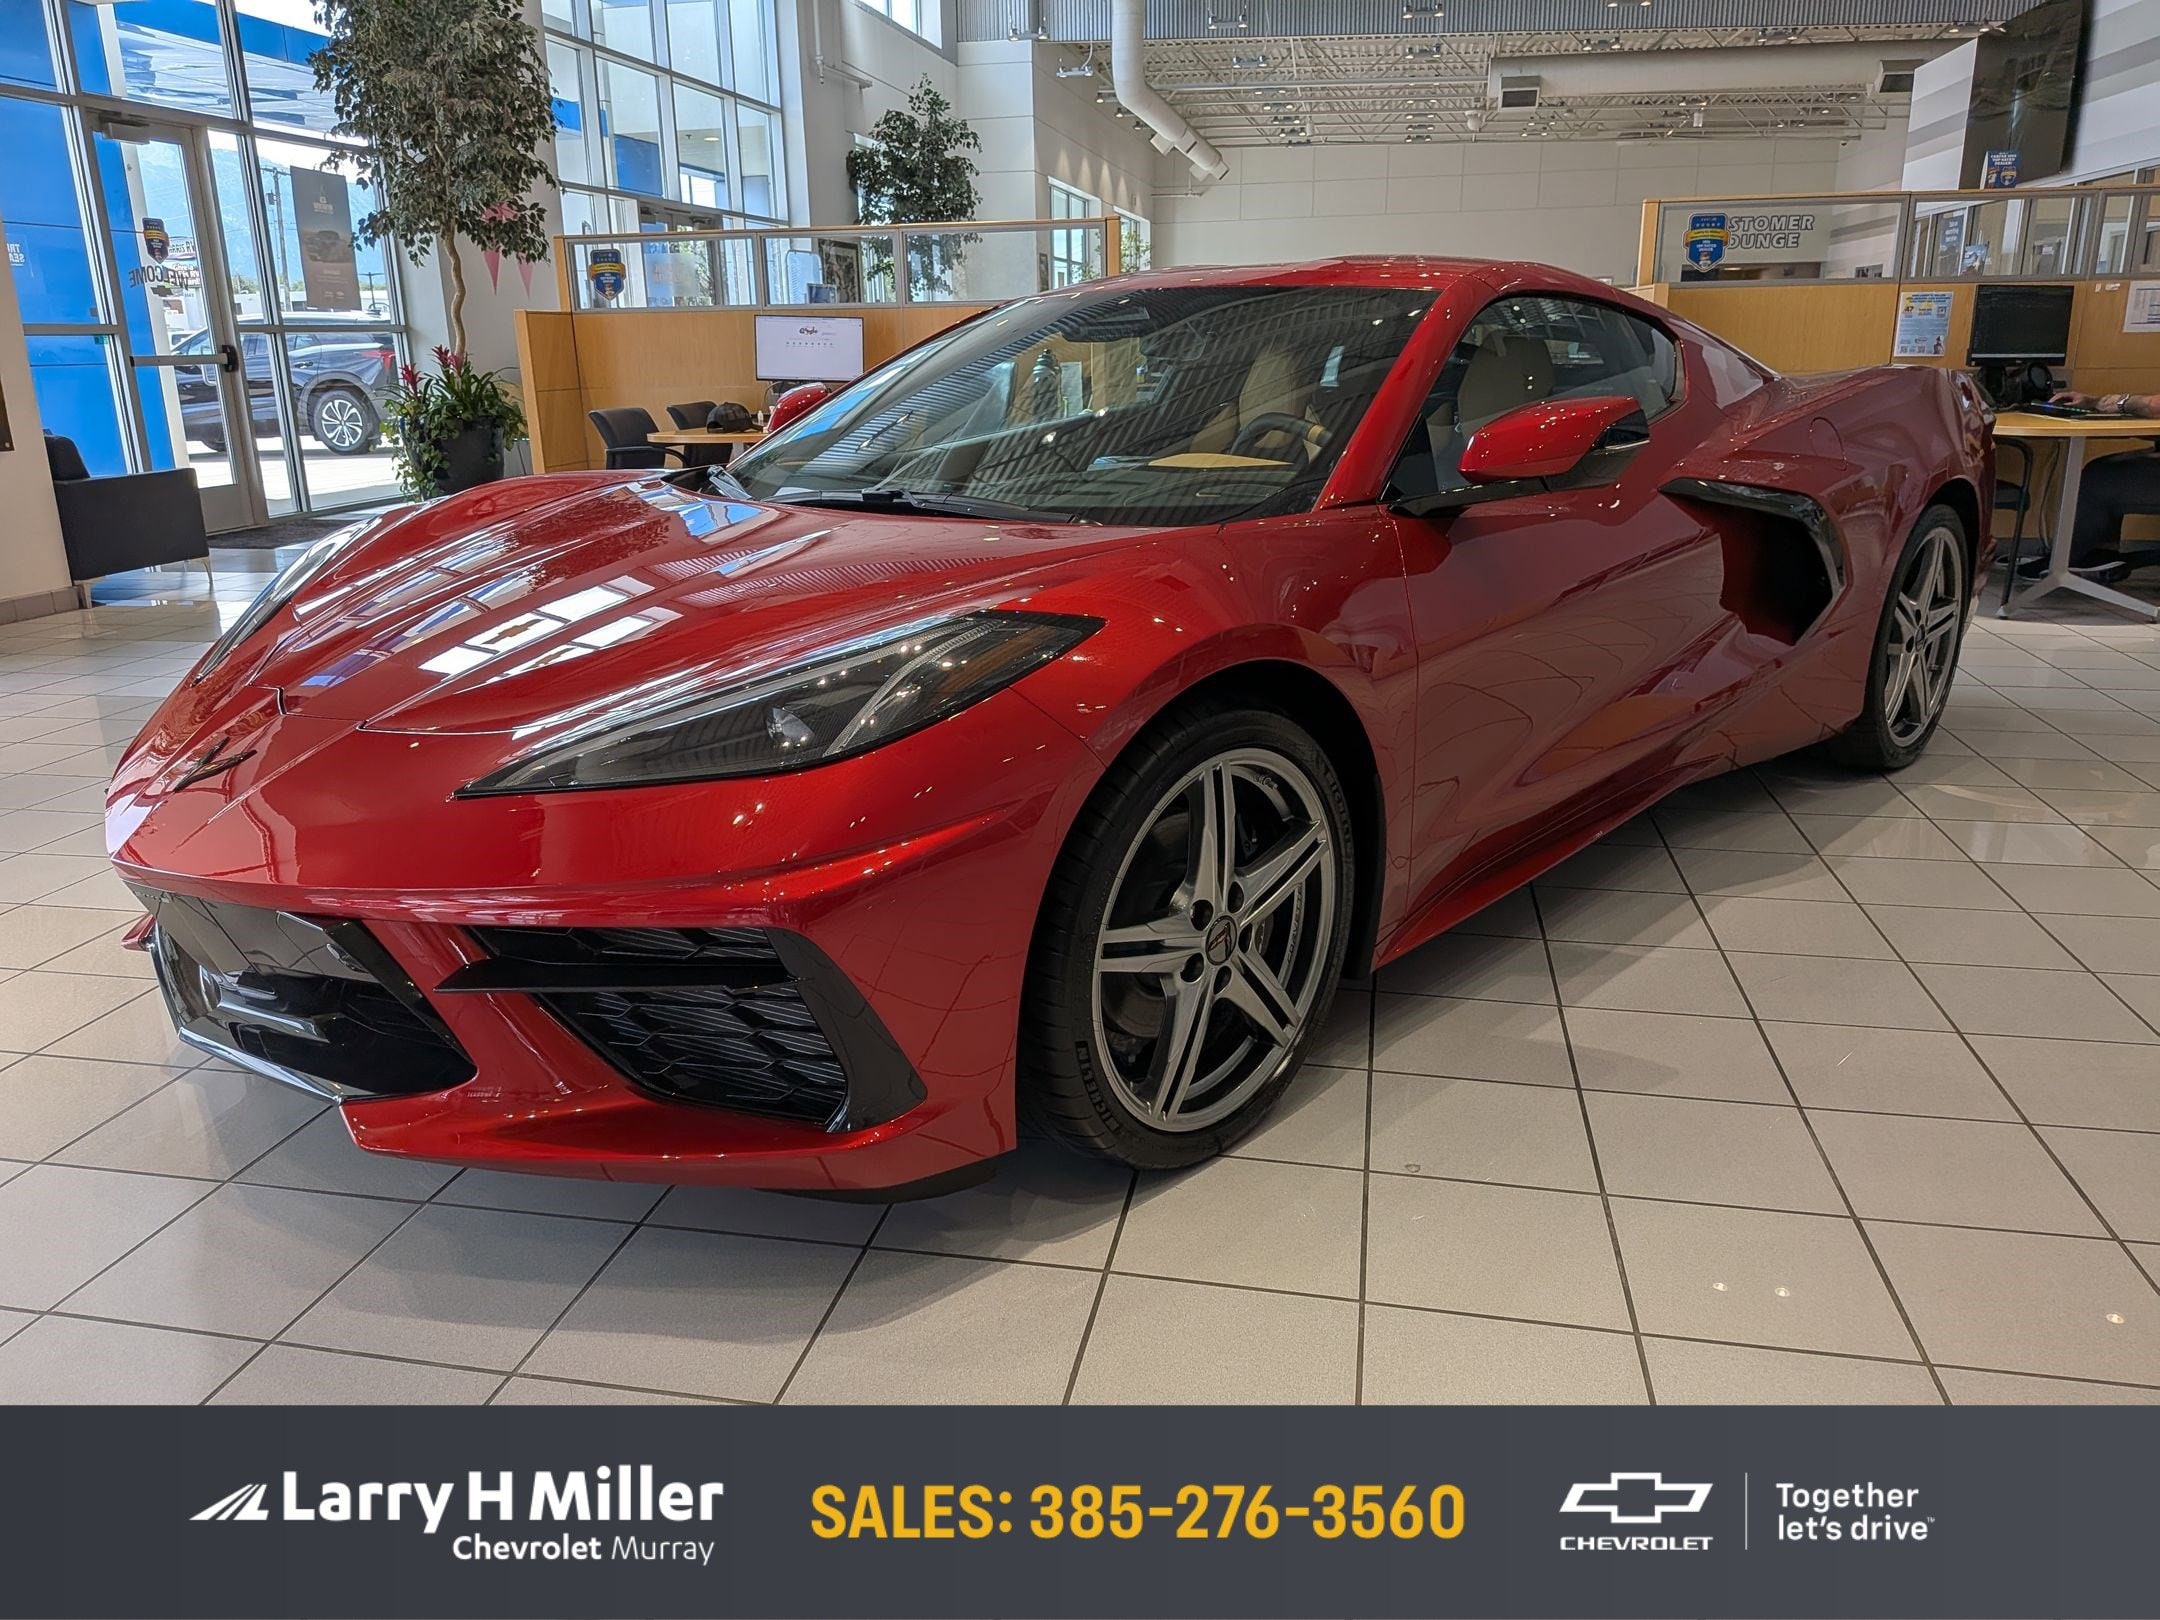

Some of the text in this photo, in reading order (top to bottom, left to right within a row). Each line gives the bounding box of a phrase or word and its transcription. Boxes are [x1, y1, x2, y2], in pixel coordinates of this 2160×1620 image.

[1728, 214, 1815, 232] STOMER
[1728, 232, 1800, 250] OUNGE
[1074, 1043, 1120, 1135] MICHELIN
